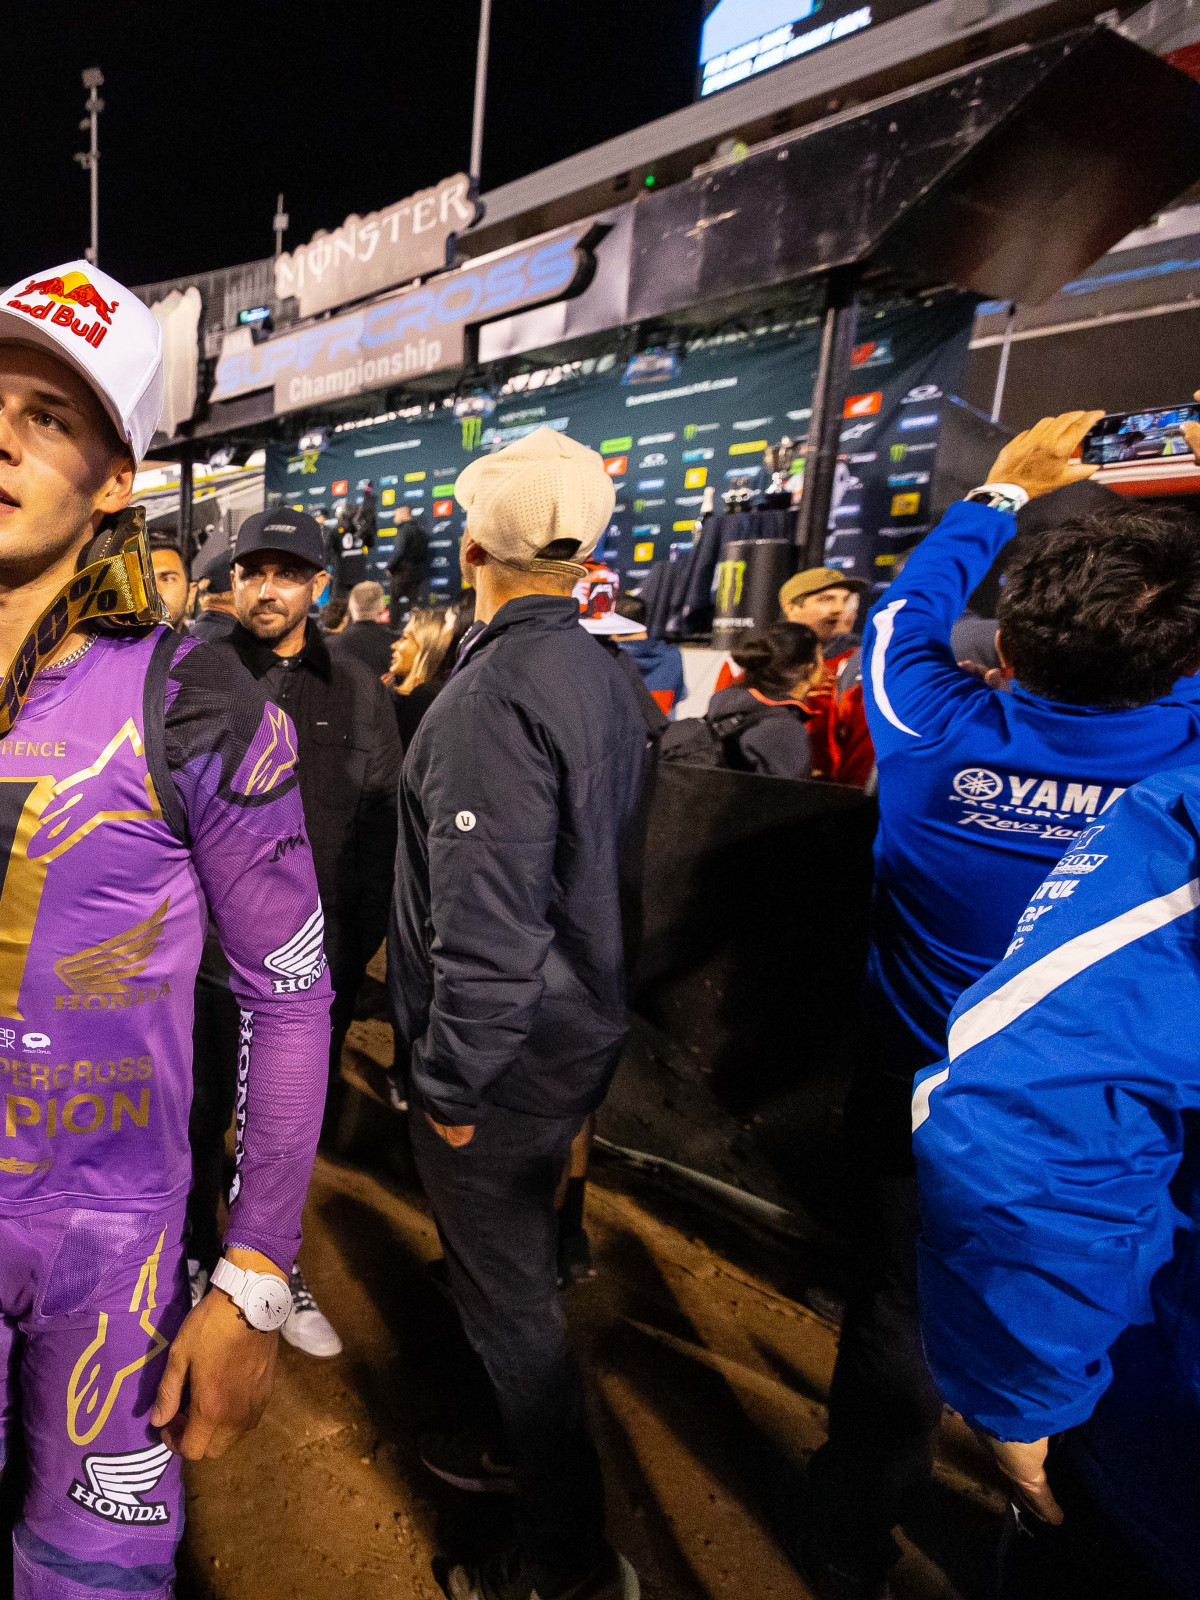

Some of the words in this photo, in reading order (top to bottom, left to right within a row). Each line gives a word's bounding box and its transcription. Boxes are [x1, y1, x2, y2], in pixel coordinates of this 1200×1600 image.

[277, 177, 471, 292] MONSTER
[51, 304, 108, 349] Bull
[289, 337, 443, 403] Championship
[948, 795, 1071, 821] FACTORY
[957, 810, 1040, 835] Revs
[1039, 825, 1083, 840] You
[54, 982, 172, 1011] HONDA
[71, 1483, 168, 1522] HONDA
